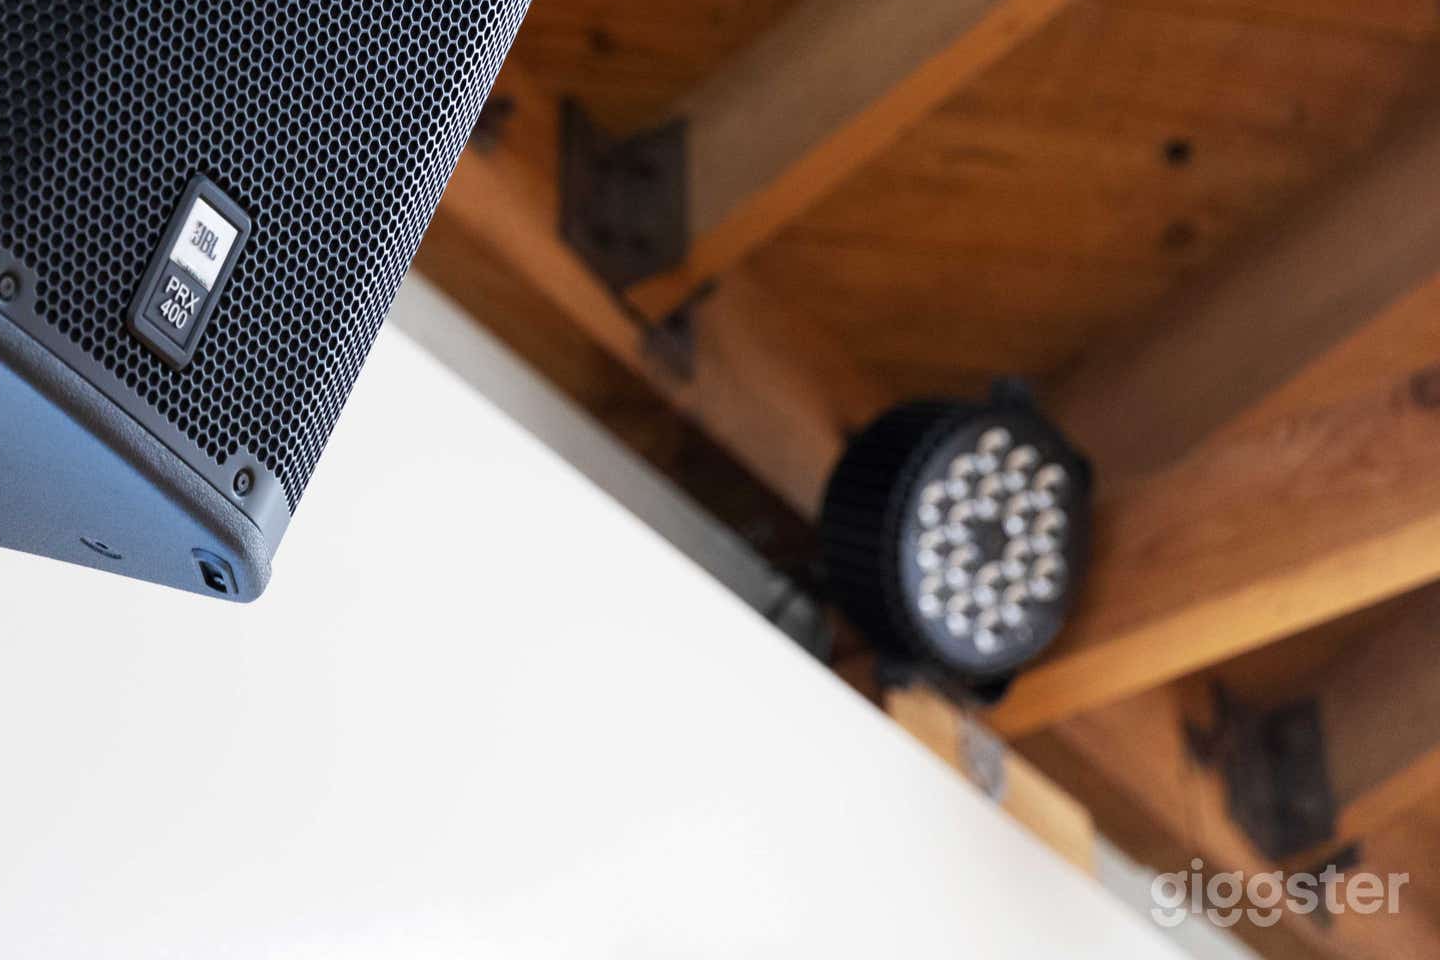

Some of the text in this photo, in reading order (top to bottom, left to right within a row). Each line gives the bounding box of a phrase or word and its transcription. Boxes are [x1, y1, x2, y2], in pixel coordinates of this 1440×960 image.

[191, 222, 219, 261] JBL
[160, 298, 188, 329] 400
[166, 276, 200, 315] PRX
